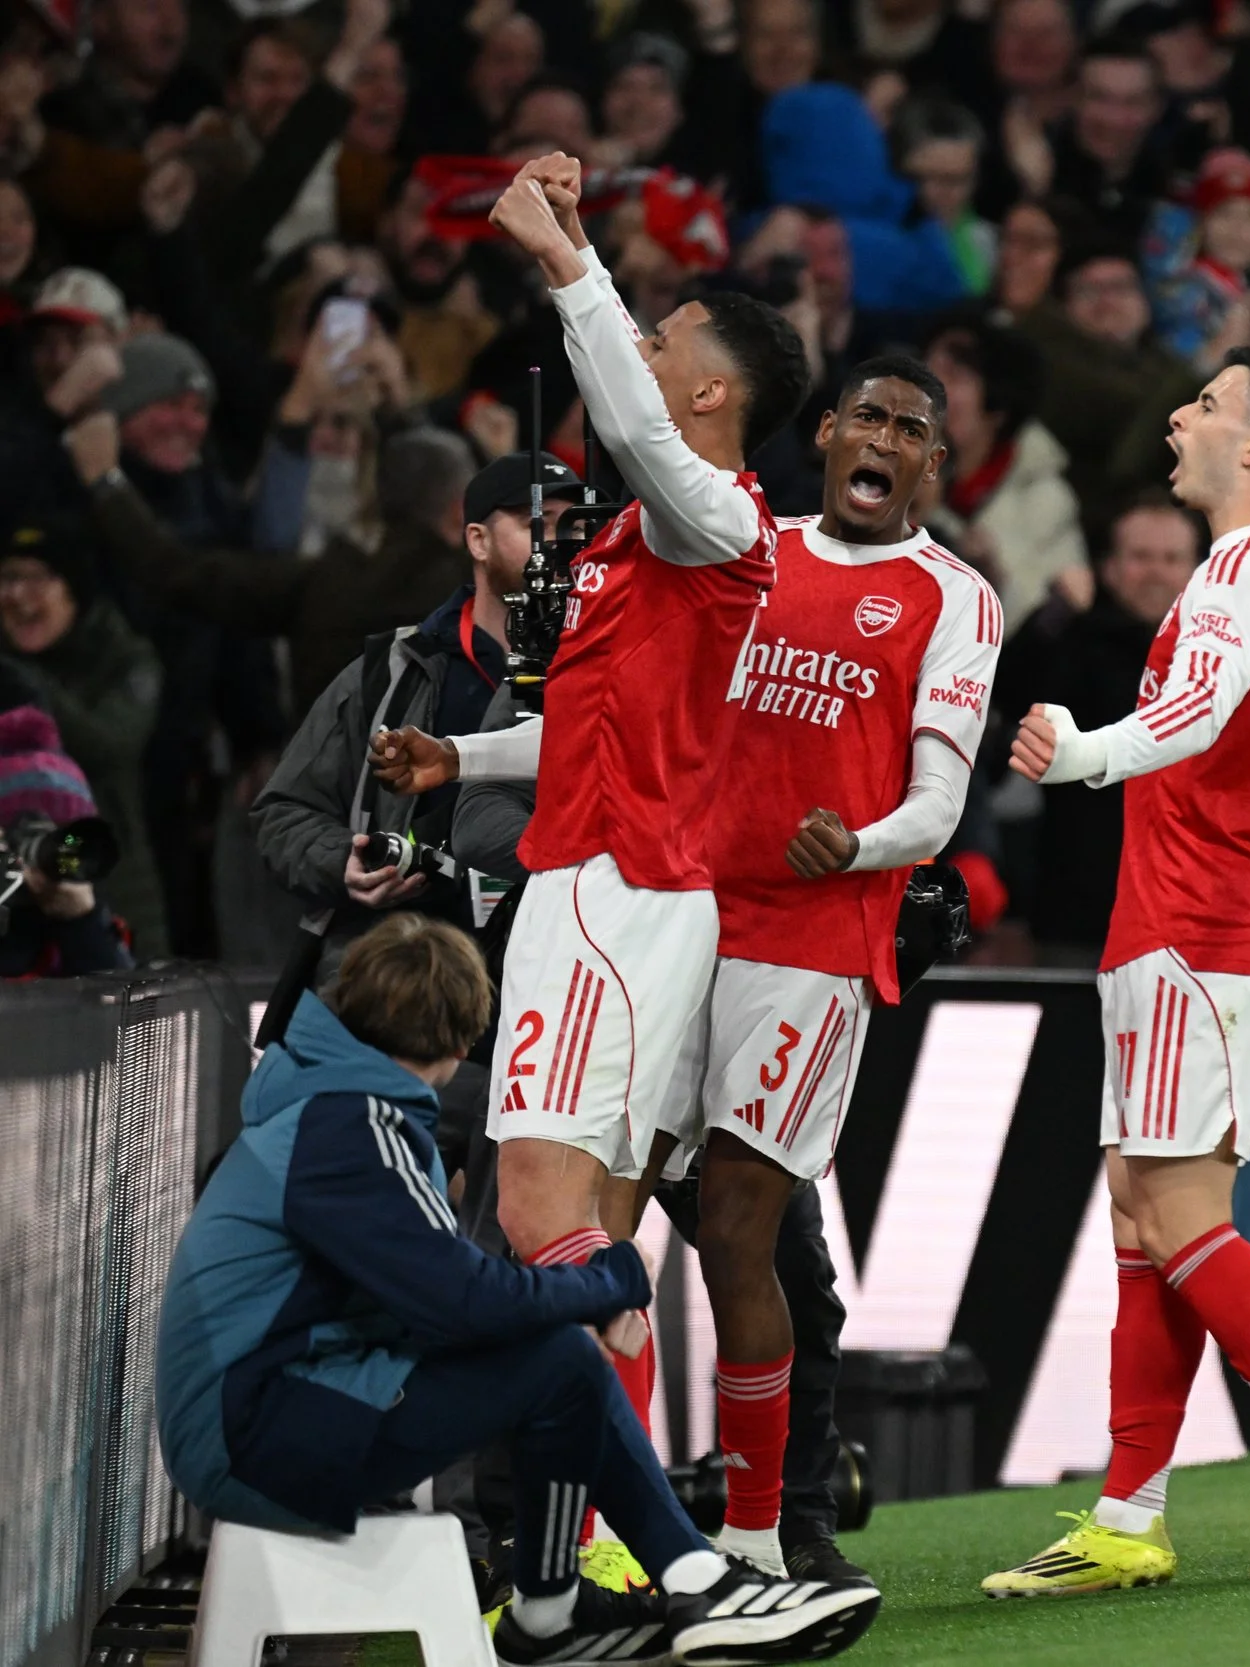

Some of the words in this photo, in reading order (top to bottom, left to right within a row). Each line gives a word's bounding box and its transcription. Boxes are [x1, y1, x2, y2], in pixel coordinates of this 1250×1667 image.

[865, 601, 896, 614] Arsenal
[1191, 612, 1232, 631] VISIT
[743, 636, 879, 699] mirates
[953, 674, 987, 698] VISIT
[757, 682, 845, 729] BETTER
[507, 1010, 545, 1078] 2
[760, 1020, 802, 1092] 3
[1117, 1031, 1138, 1099] 11
